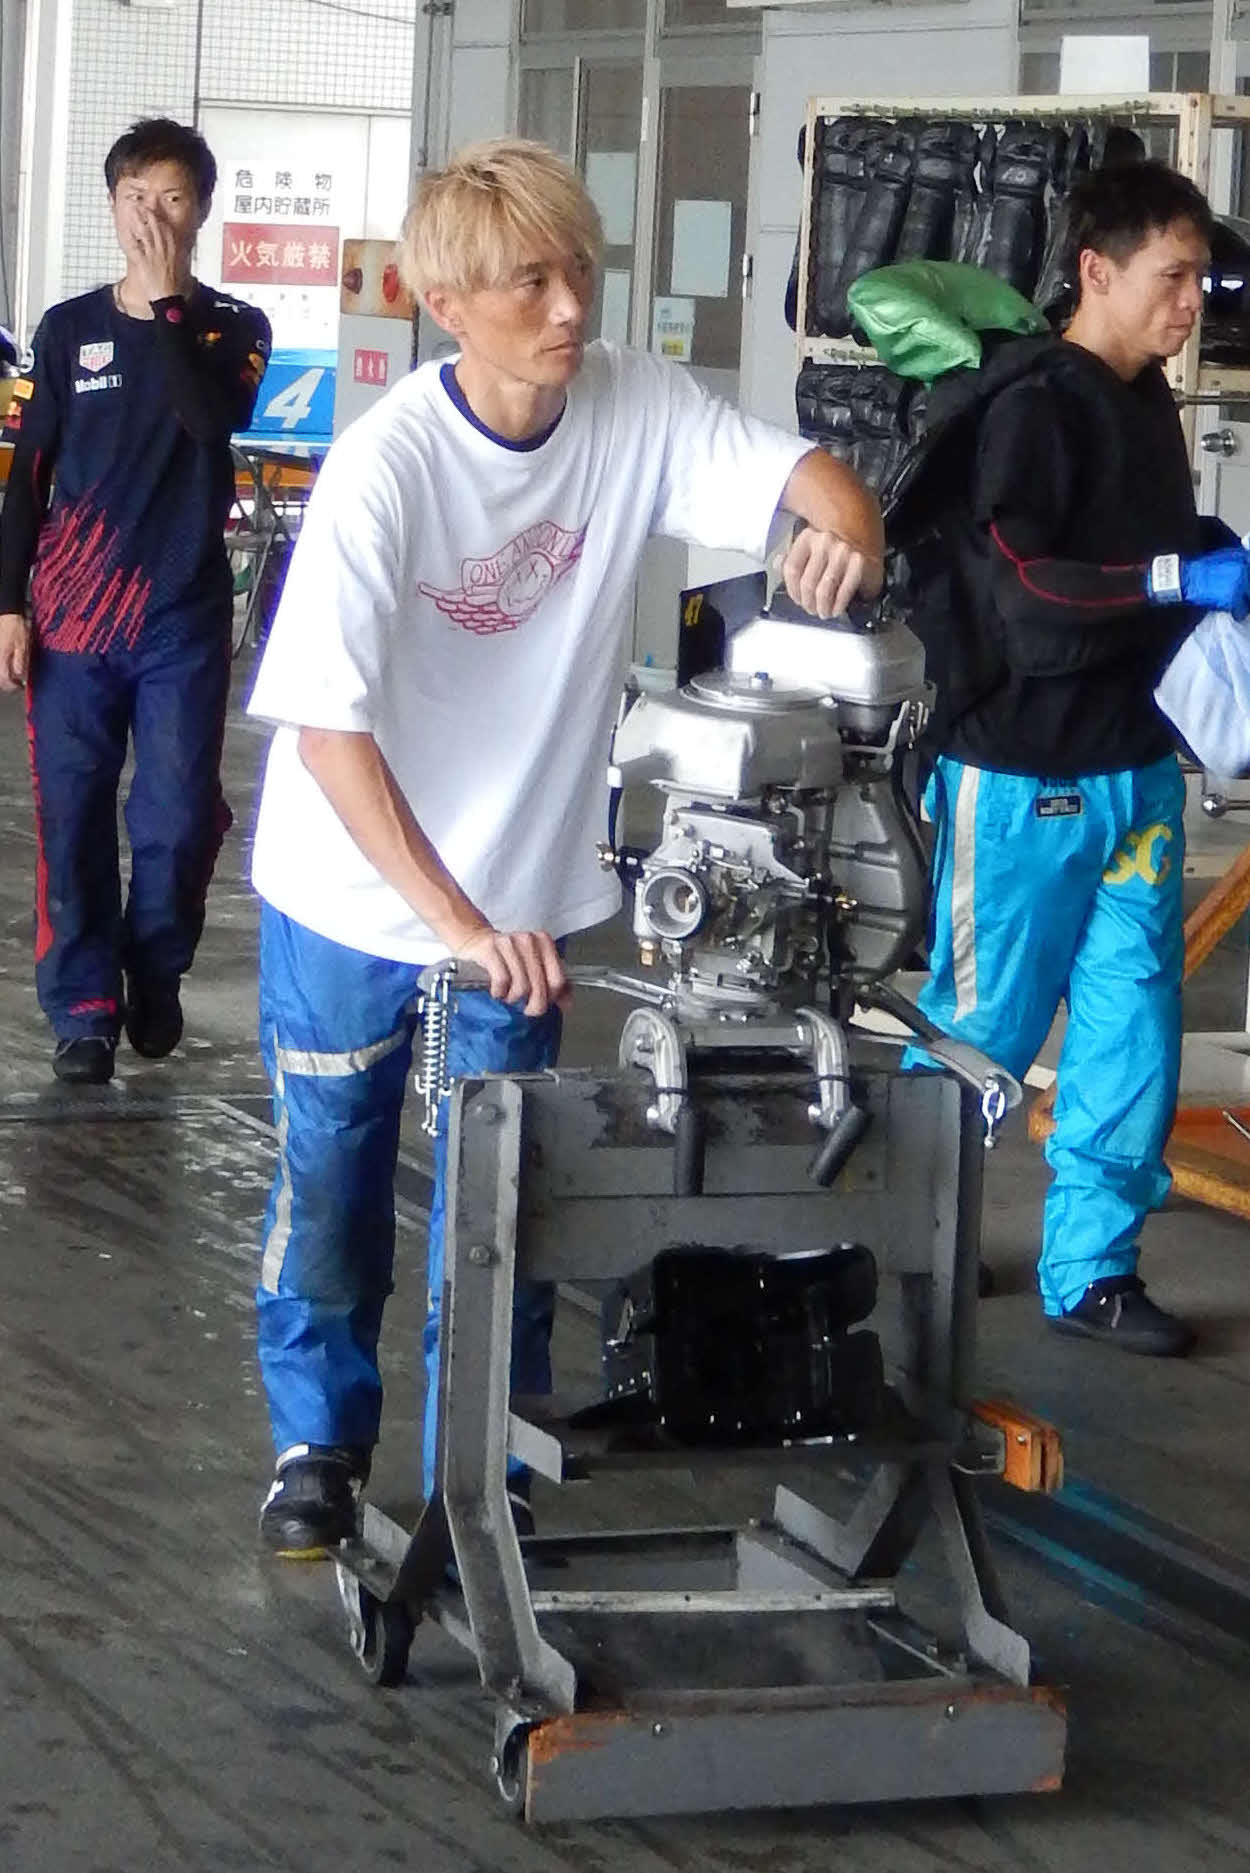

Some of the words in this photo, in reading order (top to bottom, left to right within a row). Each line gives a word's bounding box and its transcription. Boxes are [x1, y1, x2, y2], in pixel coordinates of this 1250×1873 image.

[235, 169, 332, 192] 危険物
[234, 194, 330, 216] 屋内貯蔵所
[229, 240, 332, 270] 火気厳禁
[263, 368, 326, 429] 4
